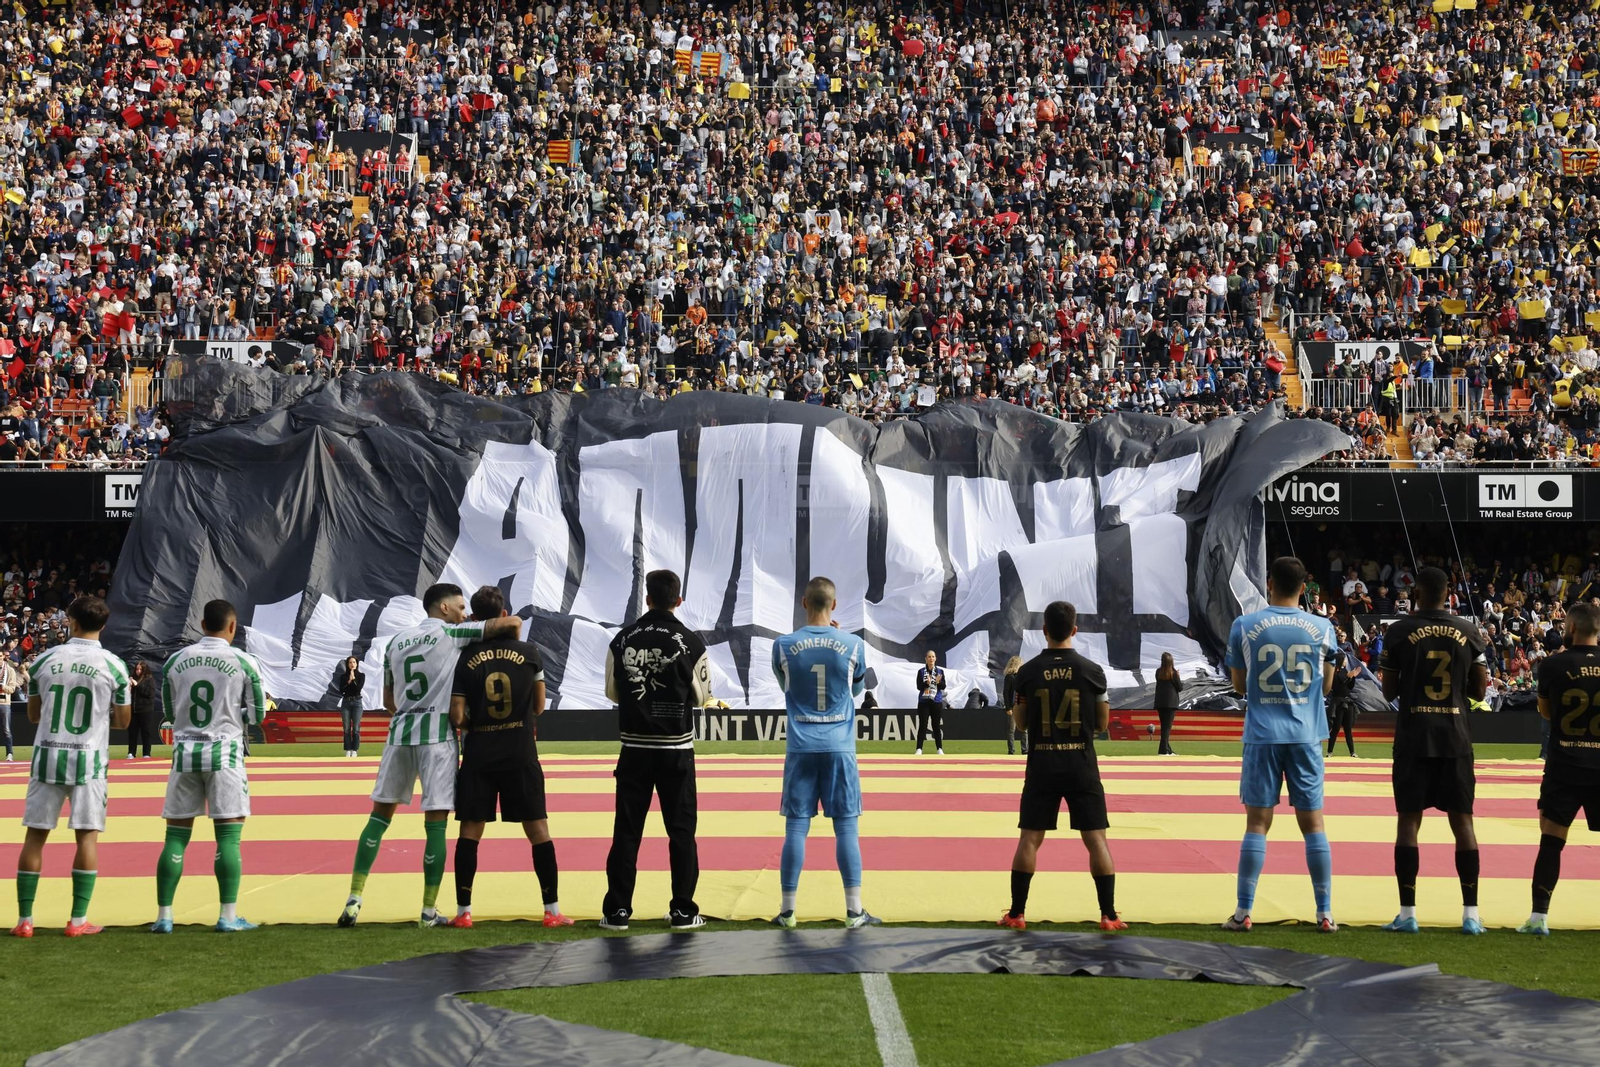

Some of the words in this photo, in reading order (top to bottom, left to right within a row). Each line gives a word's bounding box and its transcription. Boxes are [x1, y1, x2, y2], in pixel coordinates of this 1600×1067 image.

[111, 484, 140, 500] TM
[1485, 483, 1516, 500] TM
[105, 510, 119, 518] TM
[1291, 506, 1340, 518] seguros
[1479, 510, 1493, 518] TM
[1496, 510, 1514, 518] Real
[1516, 510, 1544, 518] Estate
[1545, 510, 1573, 520] Group
[1246, 616, 1324, 642] MAMARDASHVILI
[1407, 625, 1468, 647] MOSQUERA
[789, 637, 848, 656] DOMENECH
[174, 656, 203, 674] VITOR
[204, 656, 239, 678] ROQUE
[466, 649, 494, 670] HUGO
[496, 649, 525, 665] DURO
[1257, 643, 1314, 693] 25
[50, 663, 64, 675] EZ
[70, 663, 101, 679] ABDE
[403, 654, 429, 701] 5
[1043, 667, 1073, 680] GAYÀ
[1424, 650, 1452, 701] 3
[485, 671, 512, 720] 9
[810, 664, 826, 711] 1
[48, 684, 93, 735] 10
[189, 679, 215, 729] 8
[1034, 688, 1082, 737] 14
